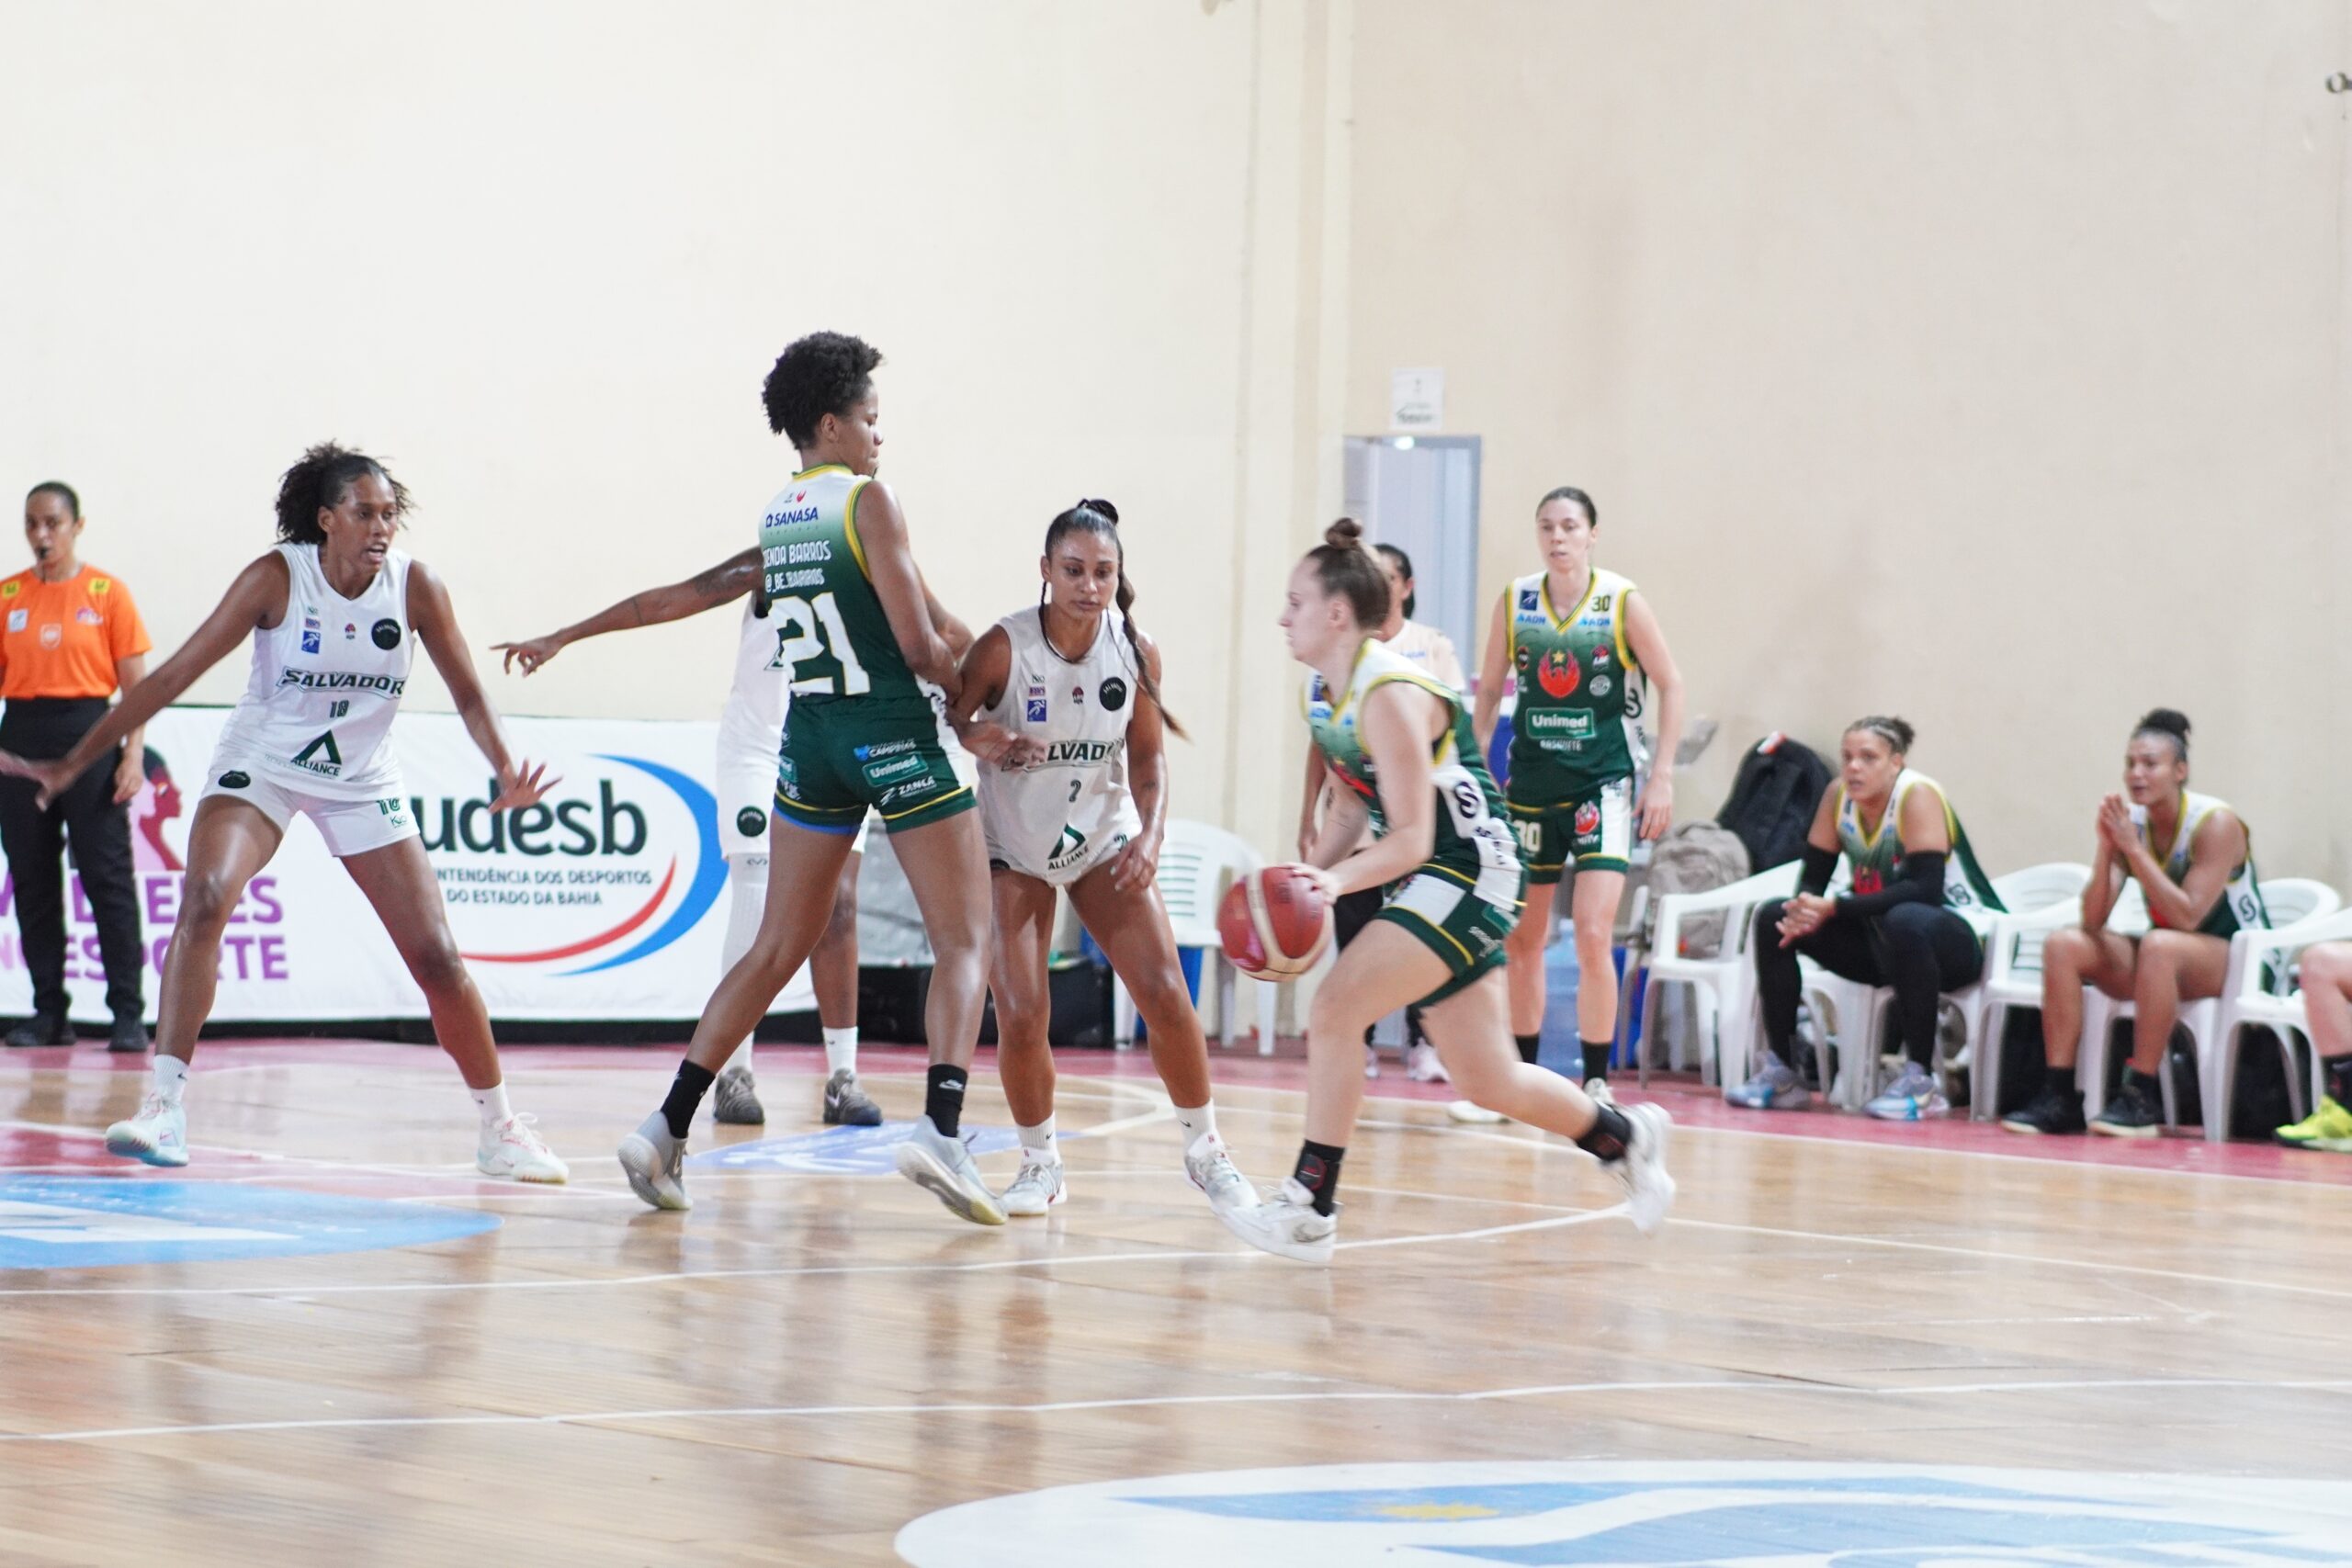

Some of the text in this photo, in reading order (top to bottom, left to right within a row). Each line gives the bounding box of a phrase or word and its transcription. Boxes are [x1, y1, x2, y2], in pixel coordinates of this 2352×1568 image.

[774, 507, 819, 526] SANASA
[788, 540, 831, 564] BARROS
[1591, 595, 1611, 612] 30
[768, 592, 871, 696] 21
[281, 669, 405, 695] SALVADOR
[1532, 714, 1588, 728] Unimed
[290, 759, 341, 777] ALLIANCE
[869, 755, 919, 778] Unimed
[411, 778, 648, 856] udesb
[434, 866, 652, 885] INTENDÊNCIA DOS DESPORTOS
[447, 889, 602, 905] DO ESTADO DA BAHIA
